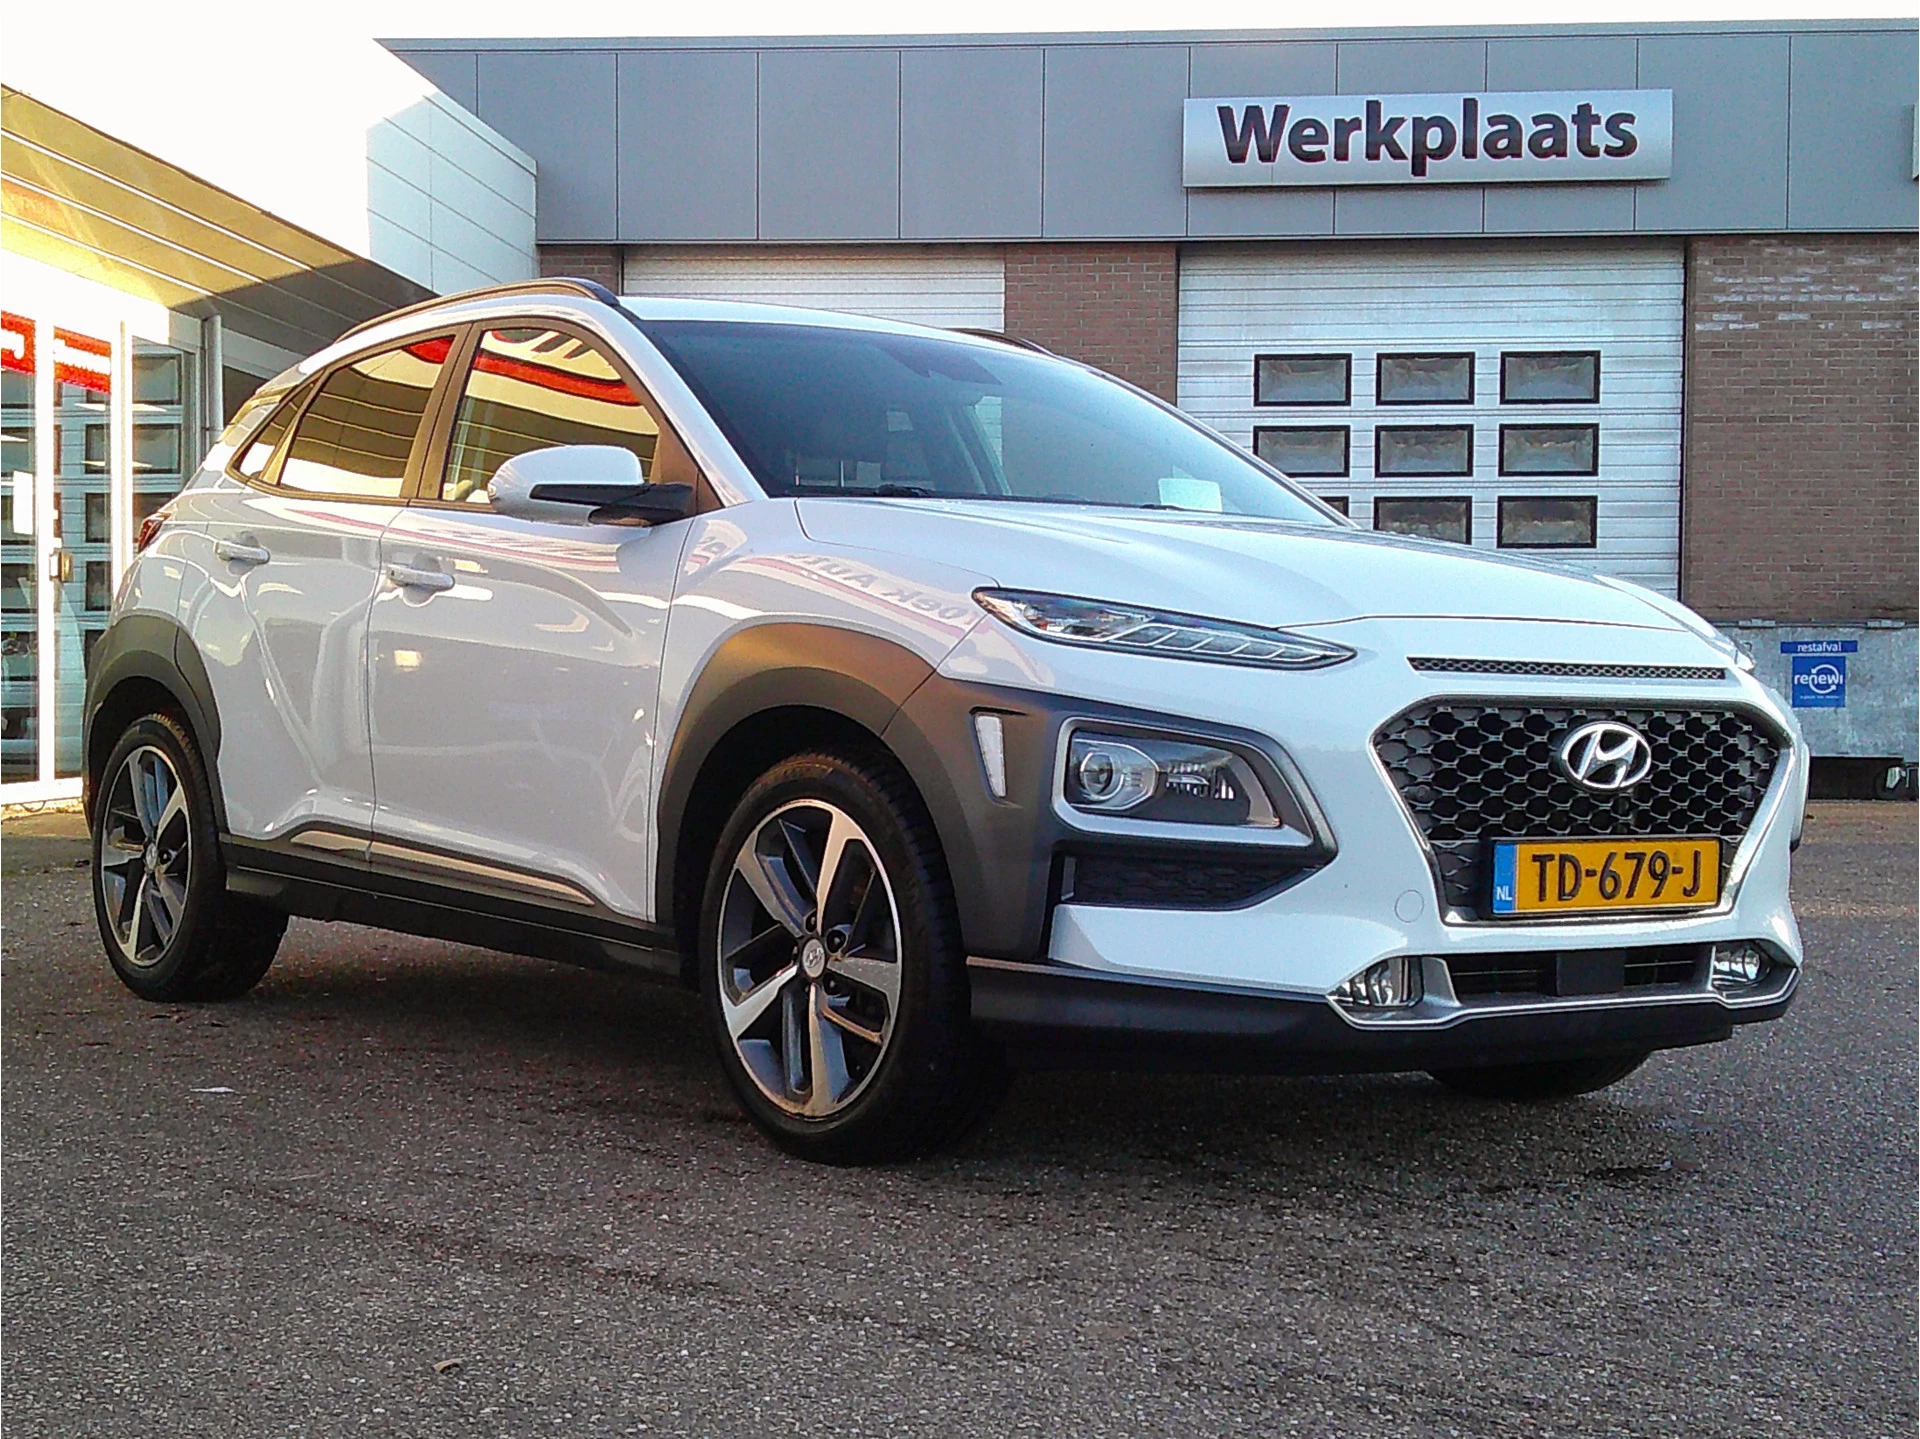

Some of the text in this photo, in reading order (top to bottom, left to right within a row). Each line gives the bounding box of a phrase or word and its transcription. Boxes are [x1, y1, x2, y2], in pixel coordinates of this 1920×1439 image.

[1217, 98, 1638, 177] Werkplaats
[1797, 641, 1842, 652] restafval
[1794, 673, 1844, 685] renewi
[1496, 849, 1701, 902] NL TD-679-J
